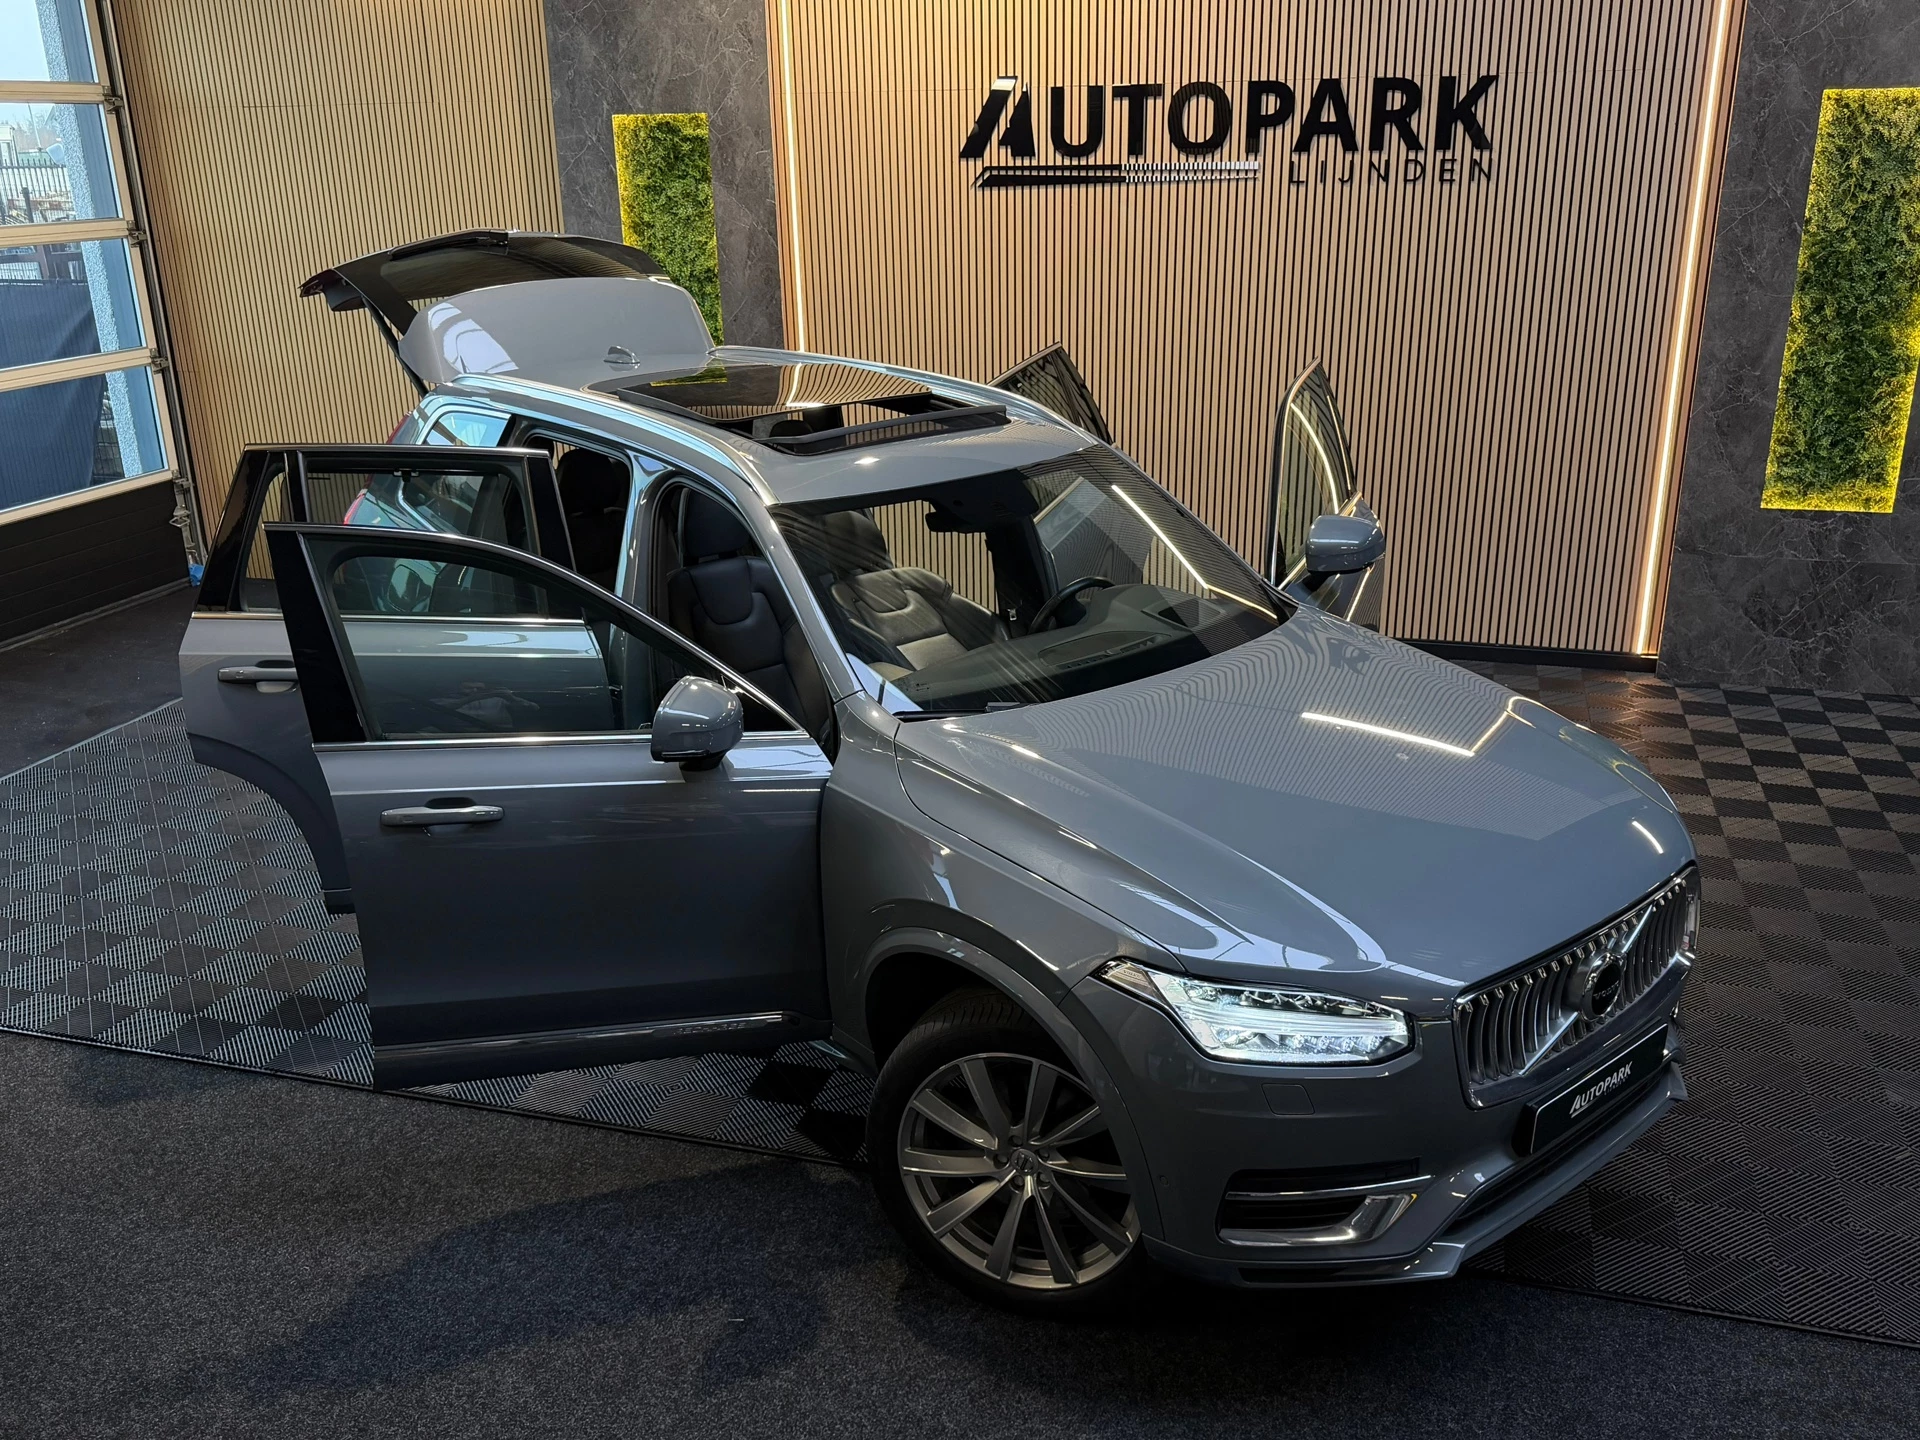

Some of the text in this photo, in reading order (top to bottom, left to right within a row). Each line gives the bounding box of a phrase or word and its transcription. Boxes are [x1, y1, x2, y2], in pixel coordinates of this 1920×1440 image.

[959, 75, 1498, 158] AUTOPARK
[1289, 158, 1493, 184] LIJNDEN
[1569, 1060, 1633, 1115] AUTOPARK
